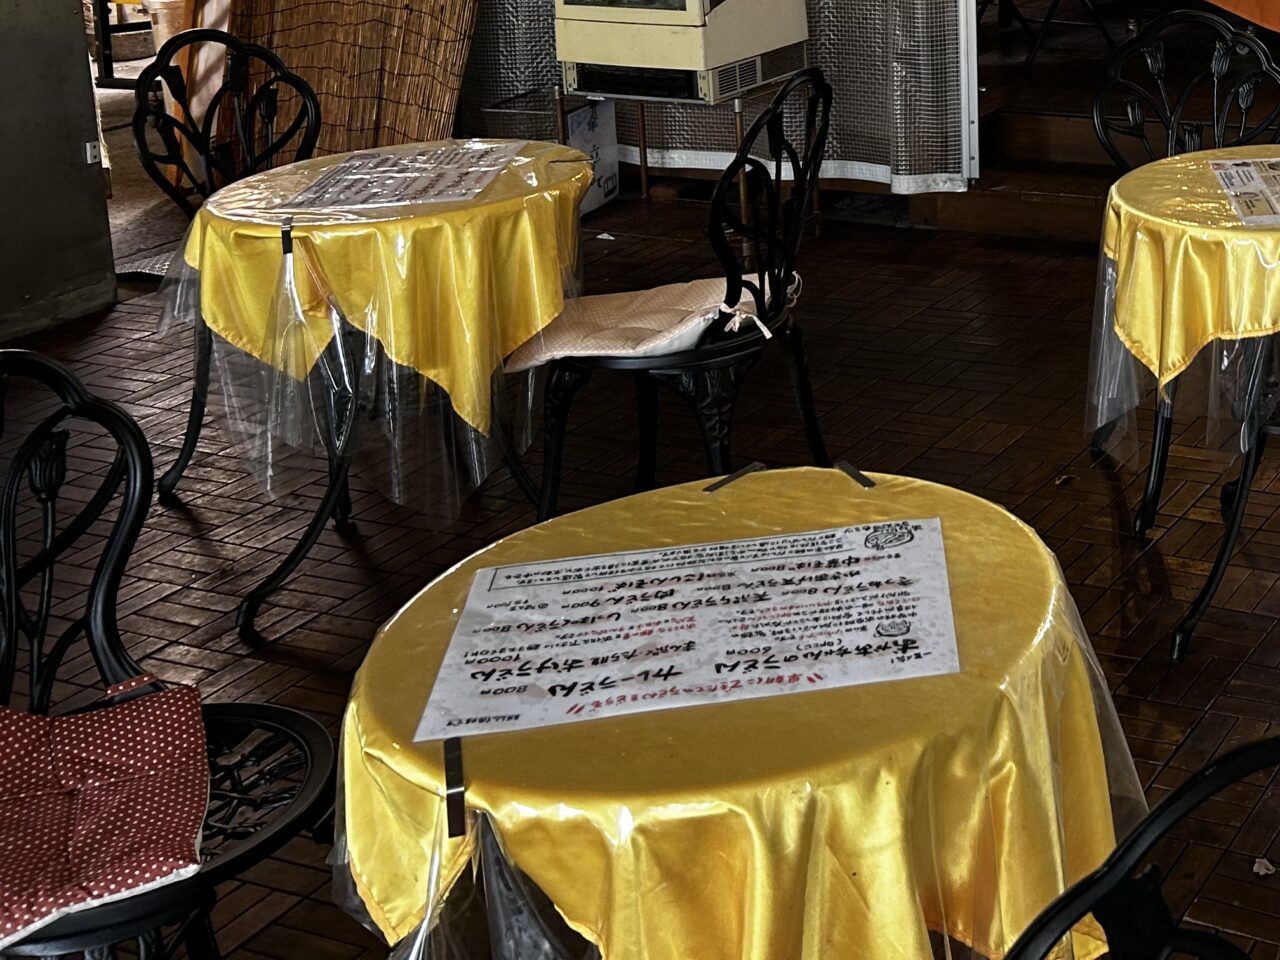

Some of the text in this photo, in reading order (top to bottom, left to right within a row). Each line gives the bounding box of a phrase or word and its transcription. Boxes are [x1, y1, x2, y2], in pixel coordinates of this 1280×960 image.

[608, 572, 705, 593] にしんそば
[823, 576, 913, 595] きつねうどん
[605, 588, 675, 605] 肉うどん
[672, 591, 771, 610] 天ぷらうどん
[715, 639, 918, 674] おかあちゃんのうどん
[548, 665, 682, 697] カレーうどん
